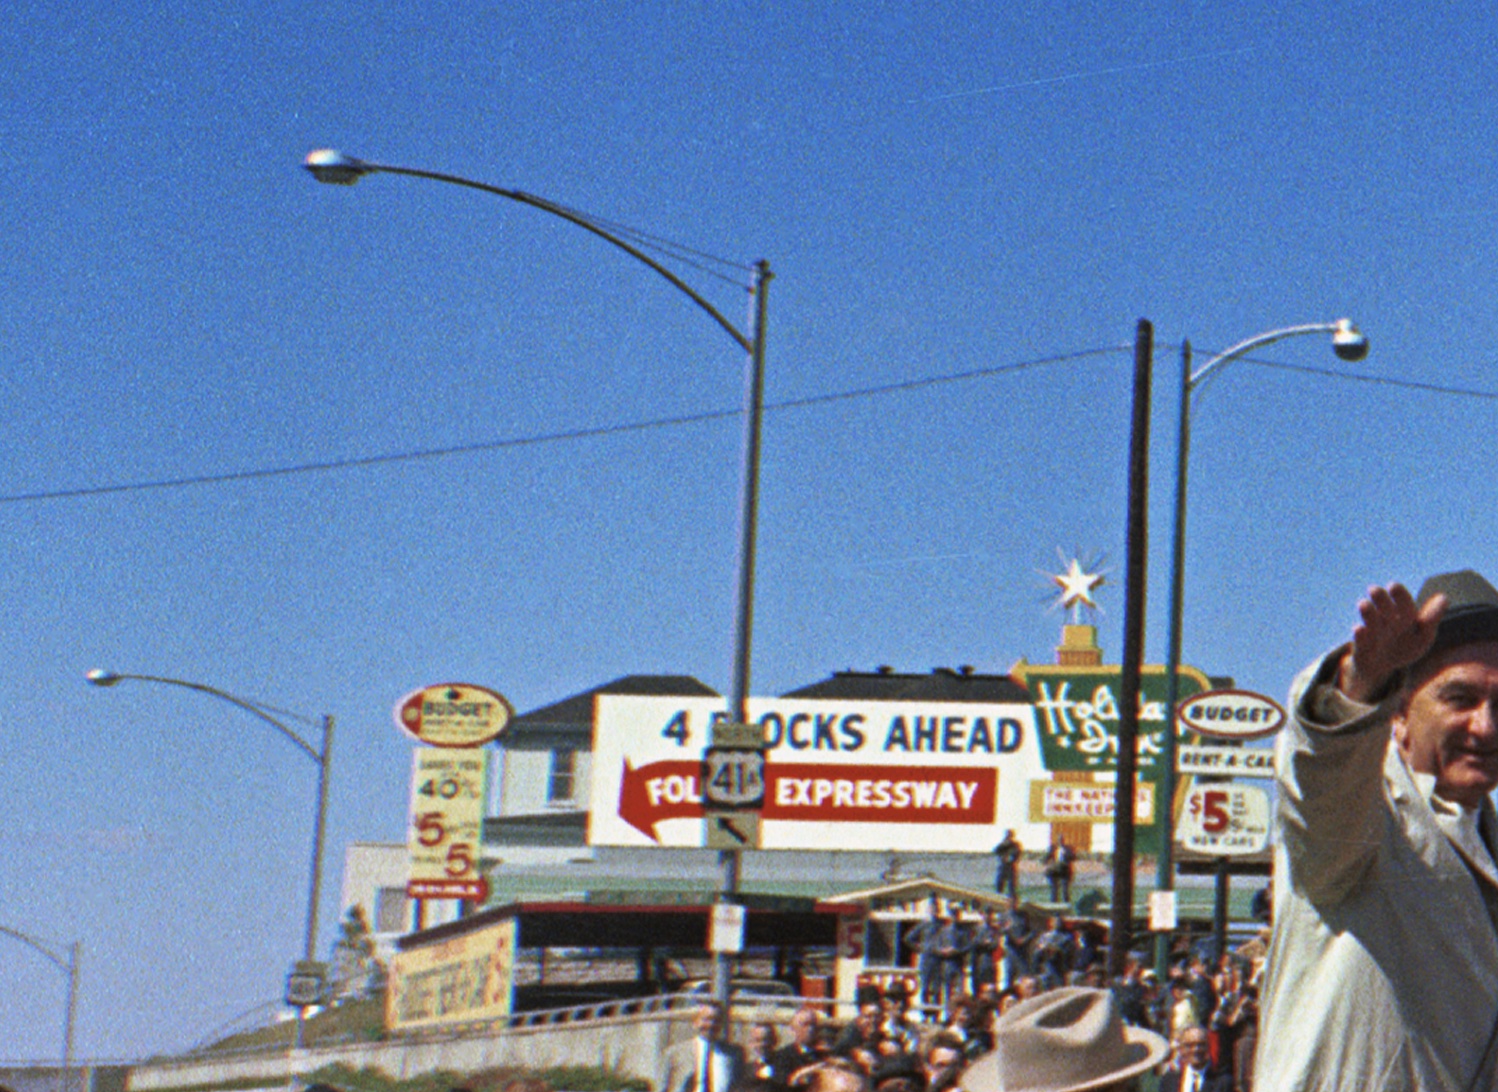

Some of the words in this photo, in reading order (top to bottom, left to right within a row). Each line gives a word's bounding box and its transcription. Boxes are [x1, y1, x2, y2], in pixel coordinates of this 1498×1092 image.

[424, 702, 492, 717] BUDGET
[1190, 705, 1274, 723] BUDGET
[661, 709, 693, 747] 4
[883, 715, 1024, 754] AHEAD
[775, 776, 978, 810] EXPRESSWAY
